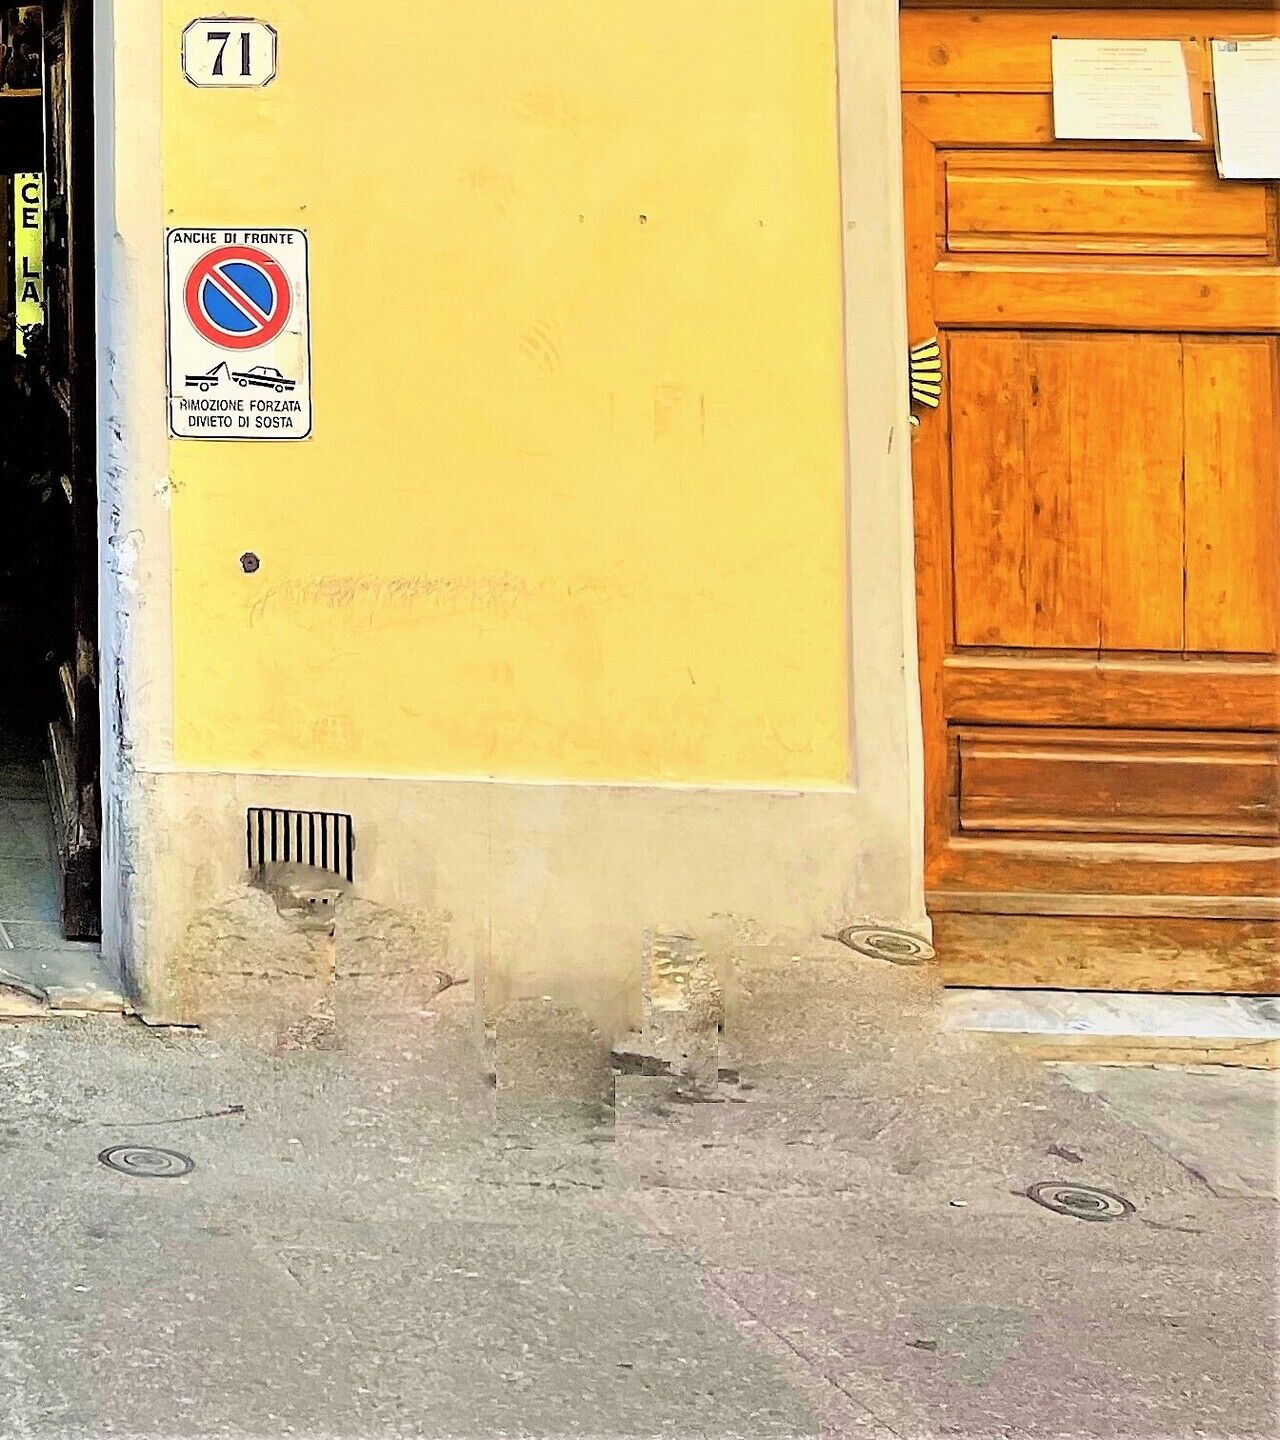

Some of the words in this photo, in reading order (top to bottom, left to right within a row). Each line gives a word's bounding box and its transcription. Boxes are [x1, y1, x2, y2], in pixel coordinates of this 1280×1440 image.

[206, 31, 252, 76] 71
[174, 232, 217, 244] ANCHE
[224, 232, 237, 244] DI
[244, 233, 294, 245] FRONTE
[180, 399, 244, 412] RIMOZIONE
[250, 400, 302, 412] FORZATA
[188, 415, 233, 428] DIVIETO
[238, 416, 250, 428] DI
[255, 416, 294, 429] SOSTA
